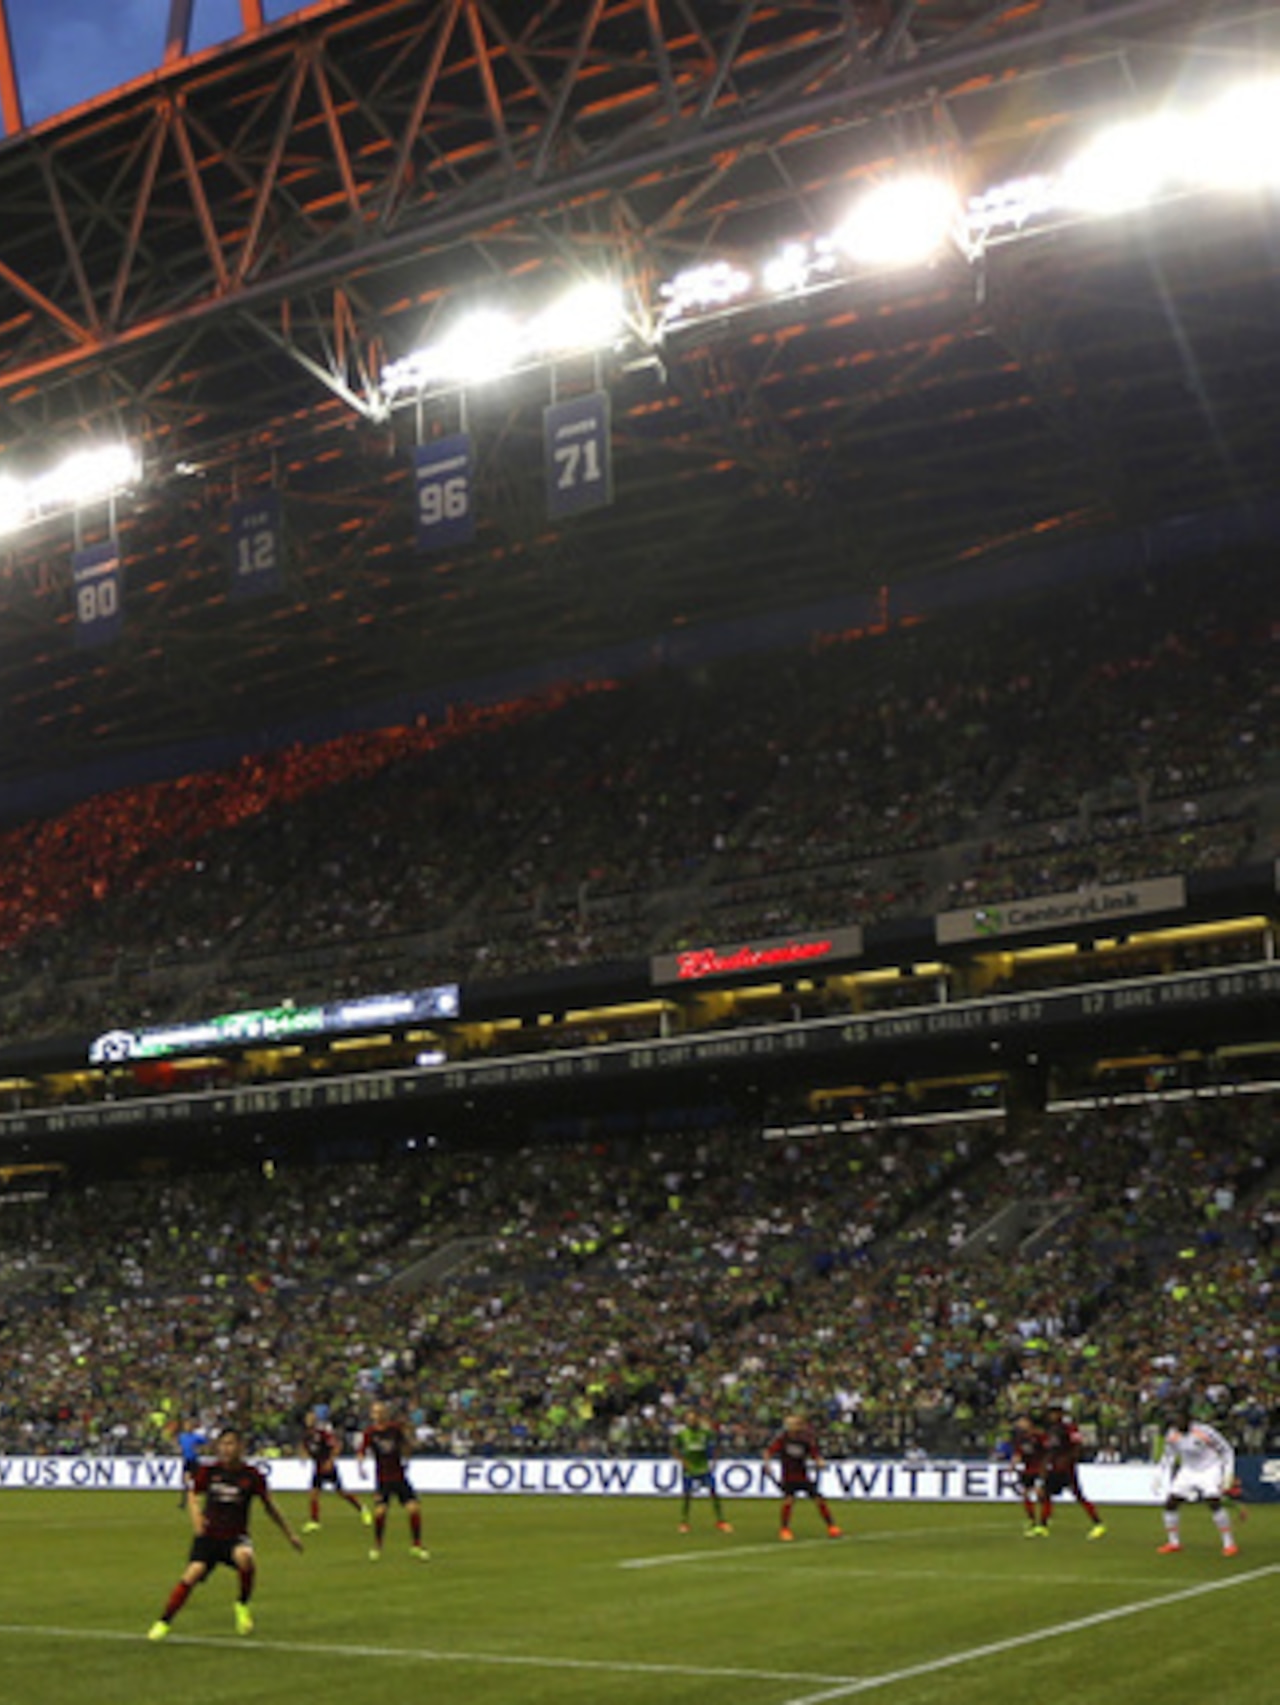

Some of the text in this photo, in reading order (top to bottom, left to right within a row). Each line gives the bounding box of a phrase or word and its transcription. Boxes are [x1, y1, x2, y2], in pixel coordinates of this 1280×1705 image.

[554, 440, 601, 489] 71
[420, 477, 468, 525] 96
[237, 531, 275, 575] 12
[77, 578, 117, 624] 80
[676, 940, 833, 979] Budweiser
[22, 1461, 60, 1485] US
[69, 1461, 113, 1485] ON
[463, 1464, 638, 1490] FOLLOW
